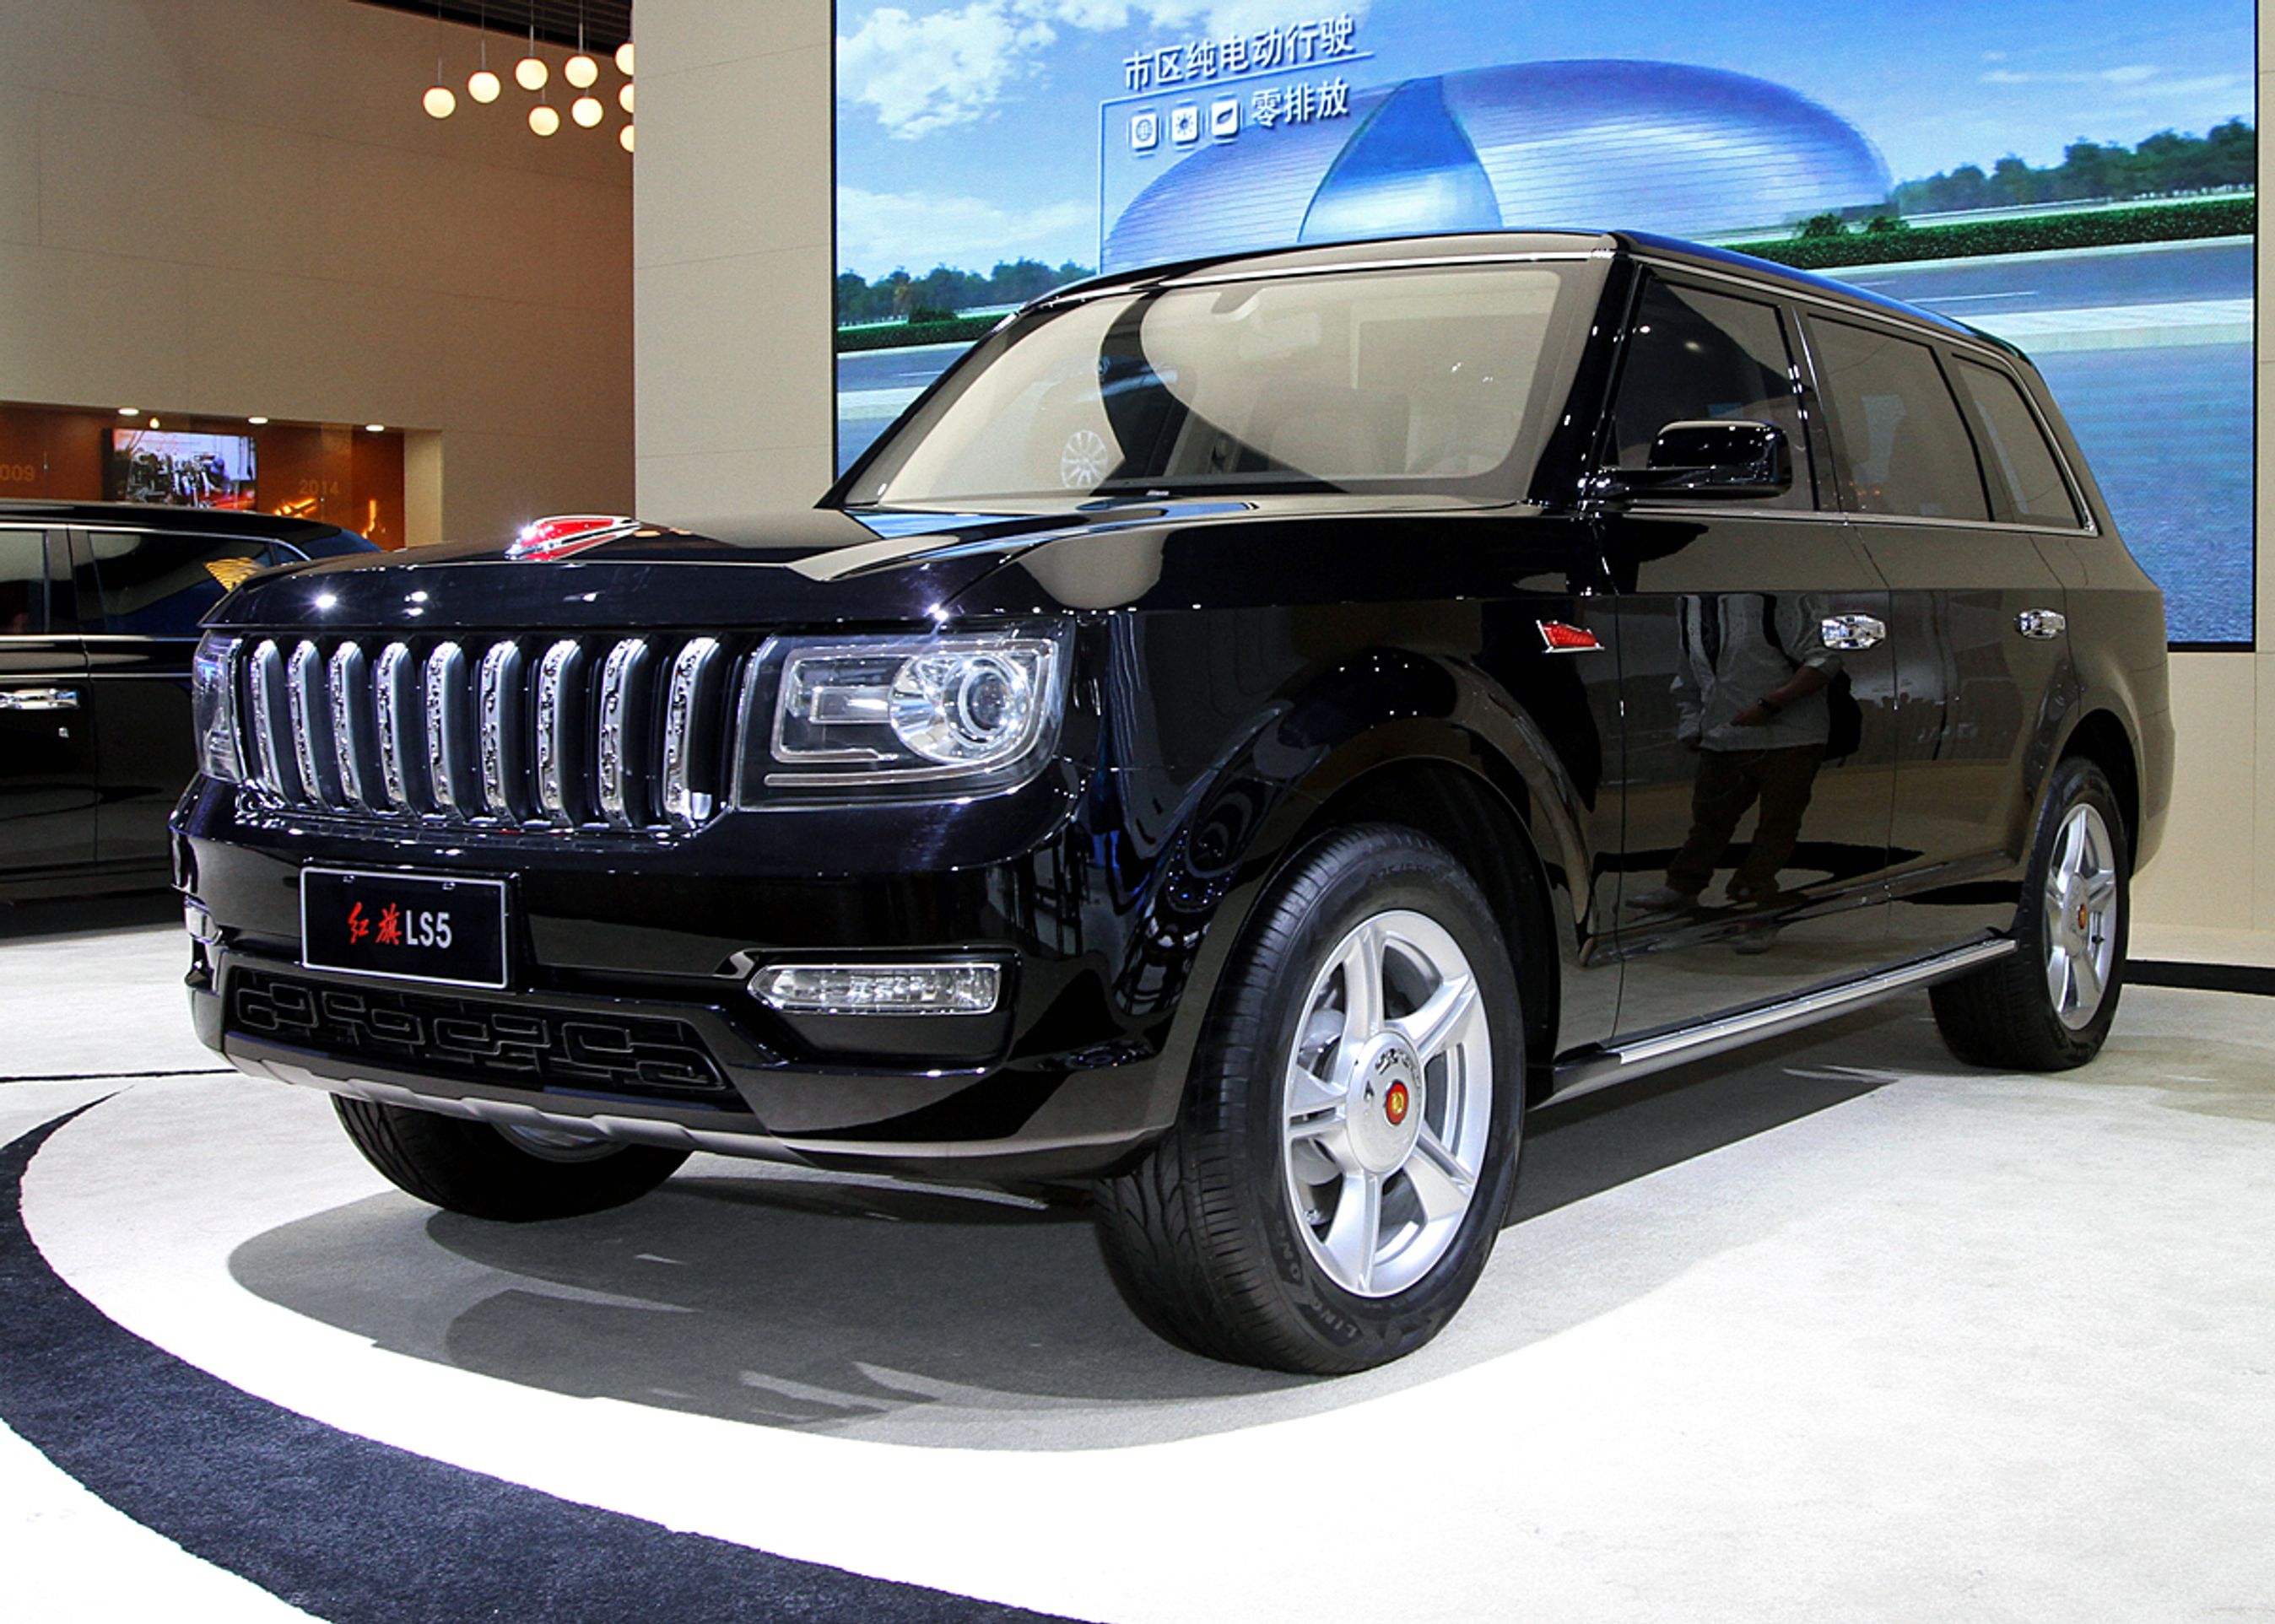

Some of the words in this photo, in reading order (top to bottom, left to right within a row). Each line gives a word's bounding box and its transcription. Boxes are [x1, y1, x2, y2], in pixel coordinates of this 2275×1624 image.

[1122, 12, 1355, 90] 市区纯电动行驶
[1251, 76, 1350, 129] 零排放
